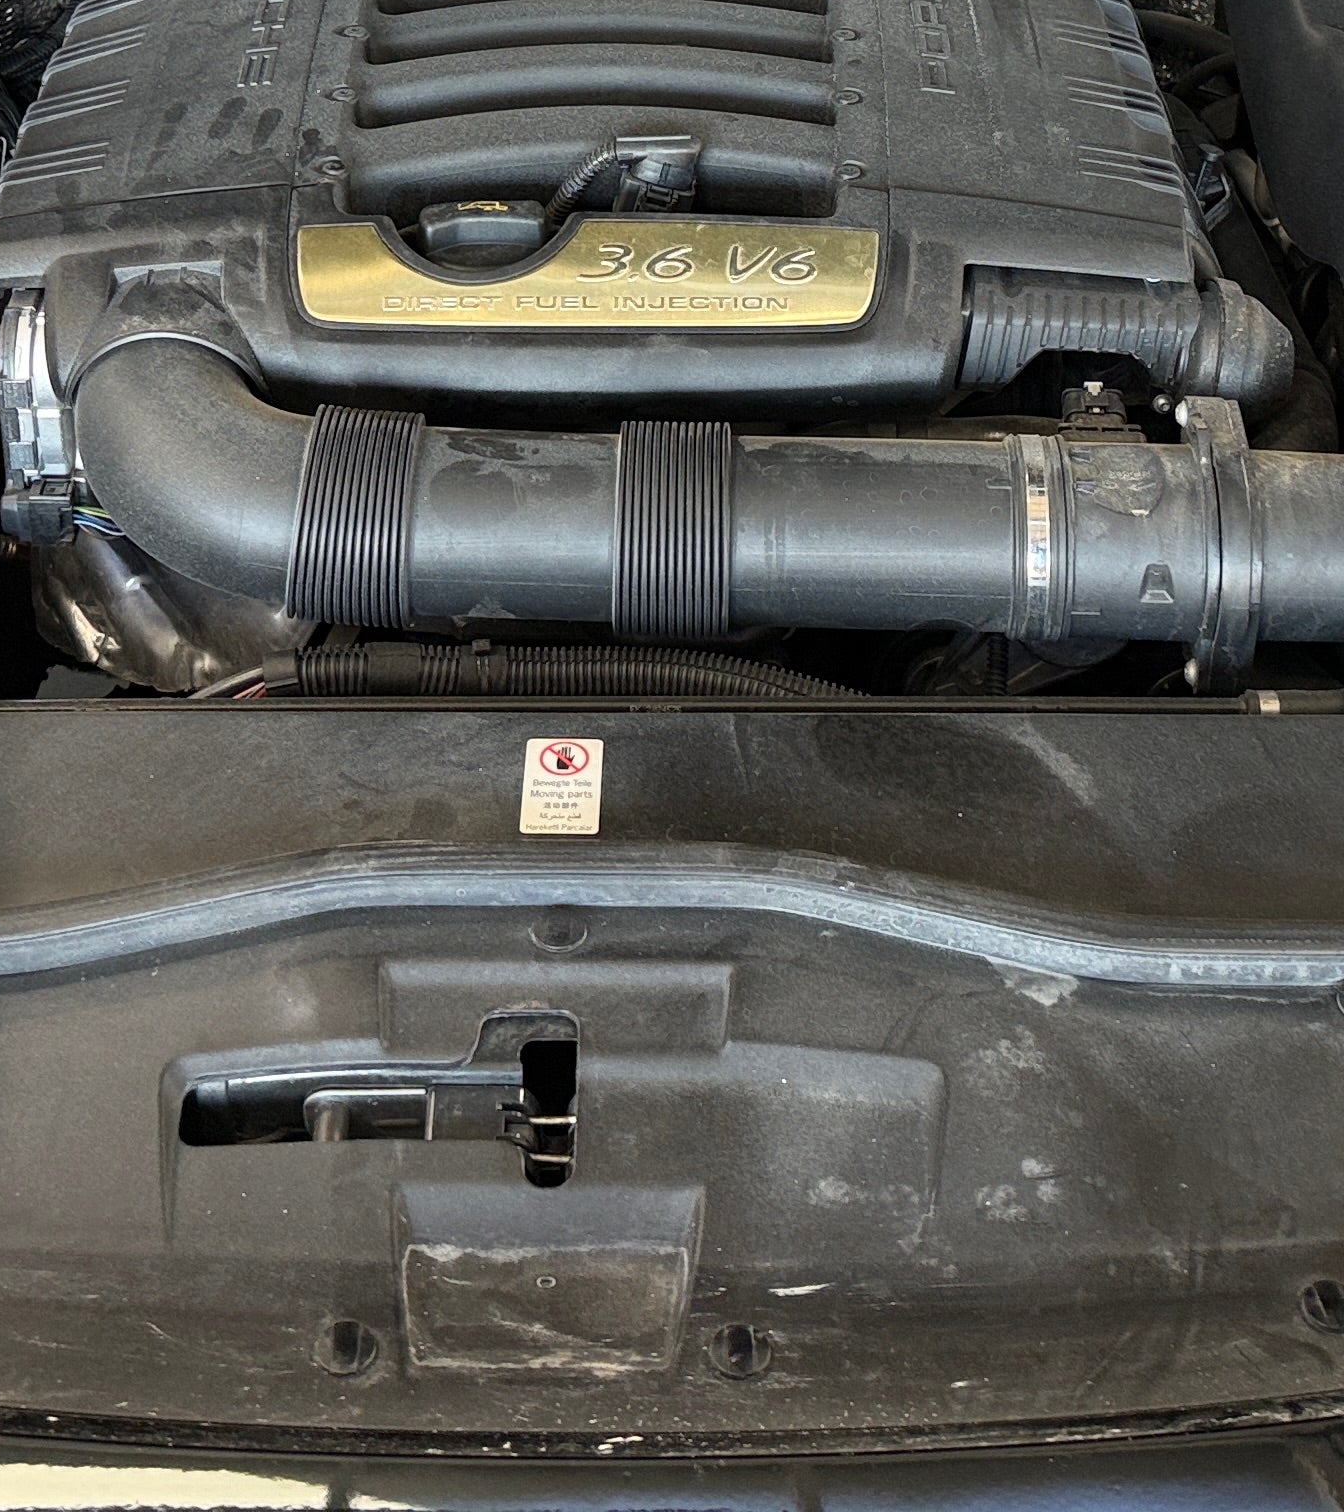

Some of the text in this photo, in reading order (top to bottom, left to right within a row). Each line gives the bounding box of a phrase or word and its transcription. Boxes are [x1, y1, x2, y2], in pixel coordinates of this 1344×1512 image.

[576, 243, 817, 284] 3.6 V6
[382, 295, 791, 312] DIRECT FUEL INJECTION
[532, 779, 570, 787] Bewegte
[530, 790, 593, 799] Moving parts
